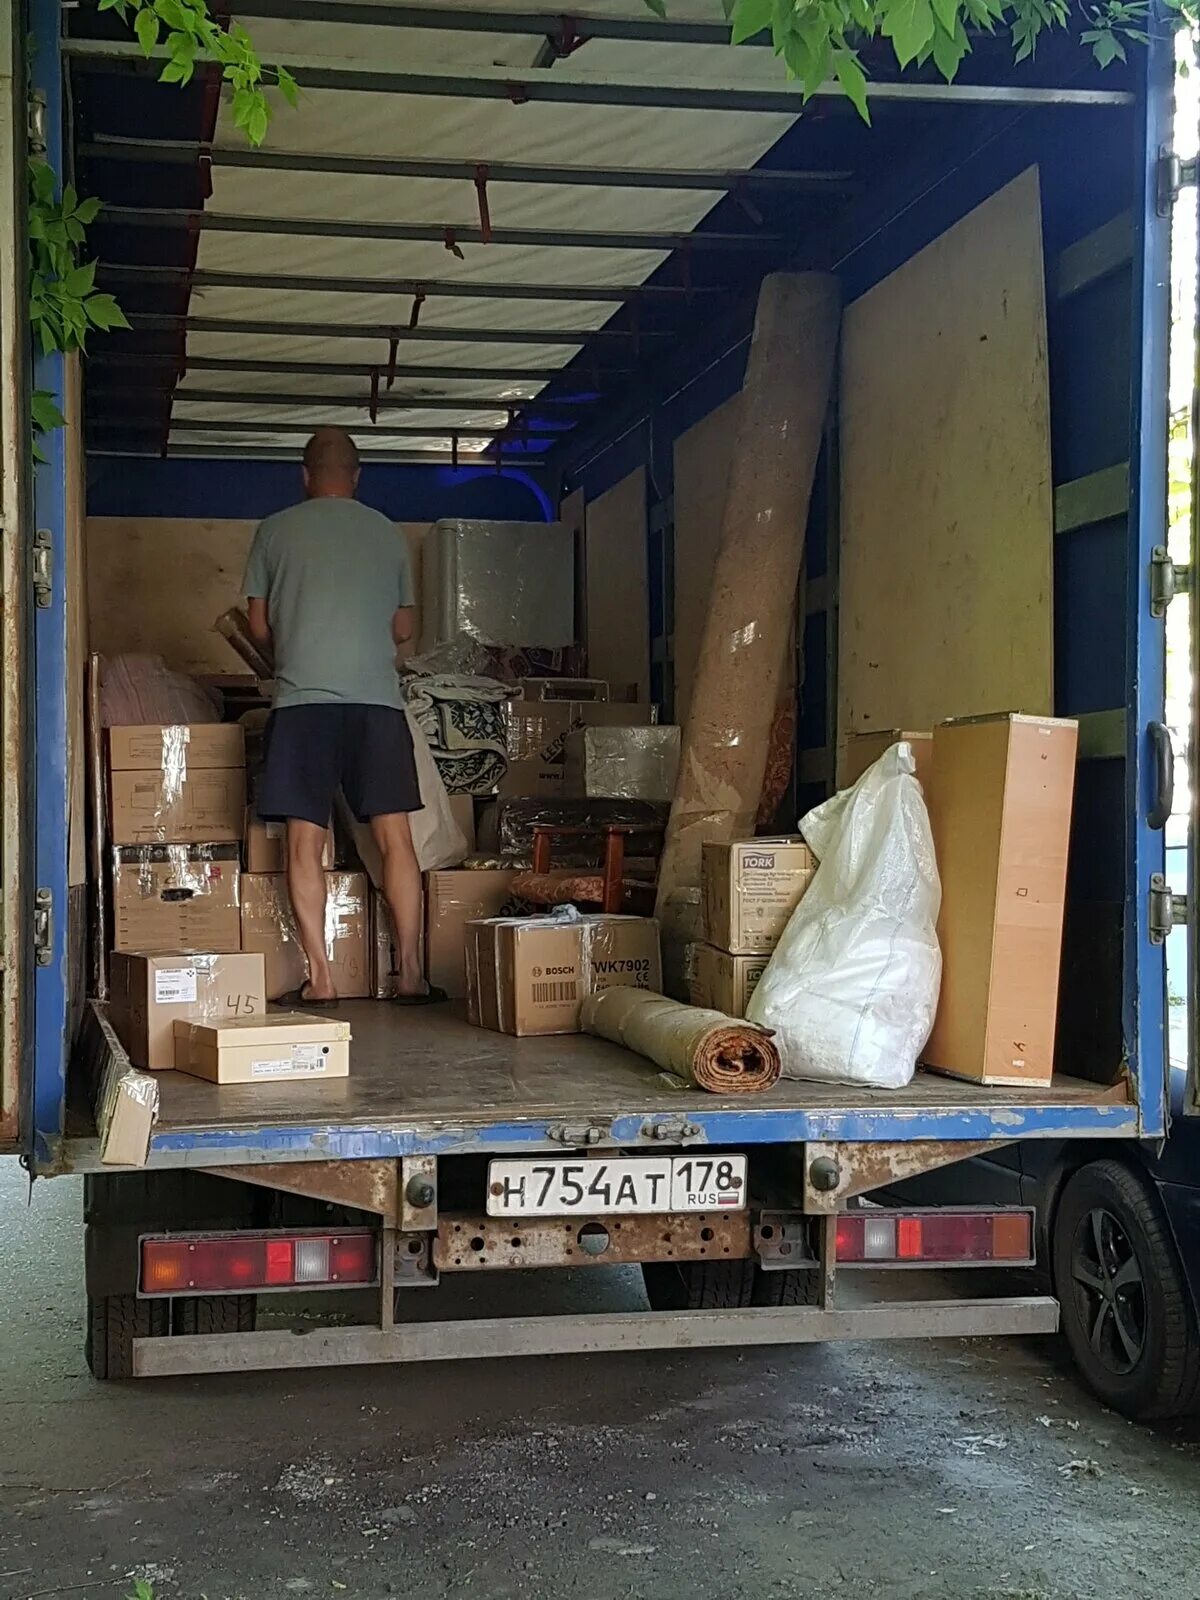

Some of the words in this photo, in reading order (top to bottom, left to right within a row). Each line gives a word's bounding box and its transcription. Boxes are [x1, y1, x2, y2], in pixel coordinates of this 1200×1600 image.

[744, 857, 773, 867] TORK
[545, 966, 575, 976] BOSCH
[591, 959, 650, 974] WK7902
[226, 994, 259, 1015] 45
[676, 1160, 733, 1193] 178
[687, 1193, 717, 1205] RUS
